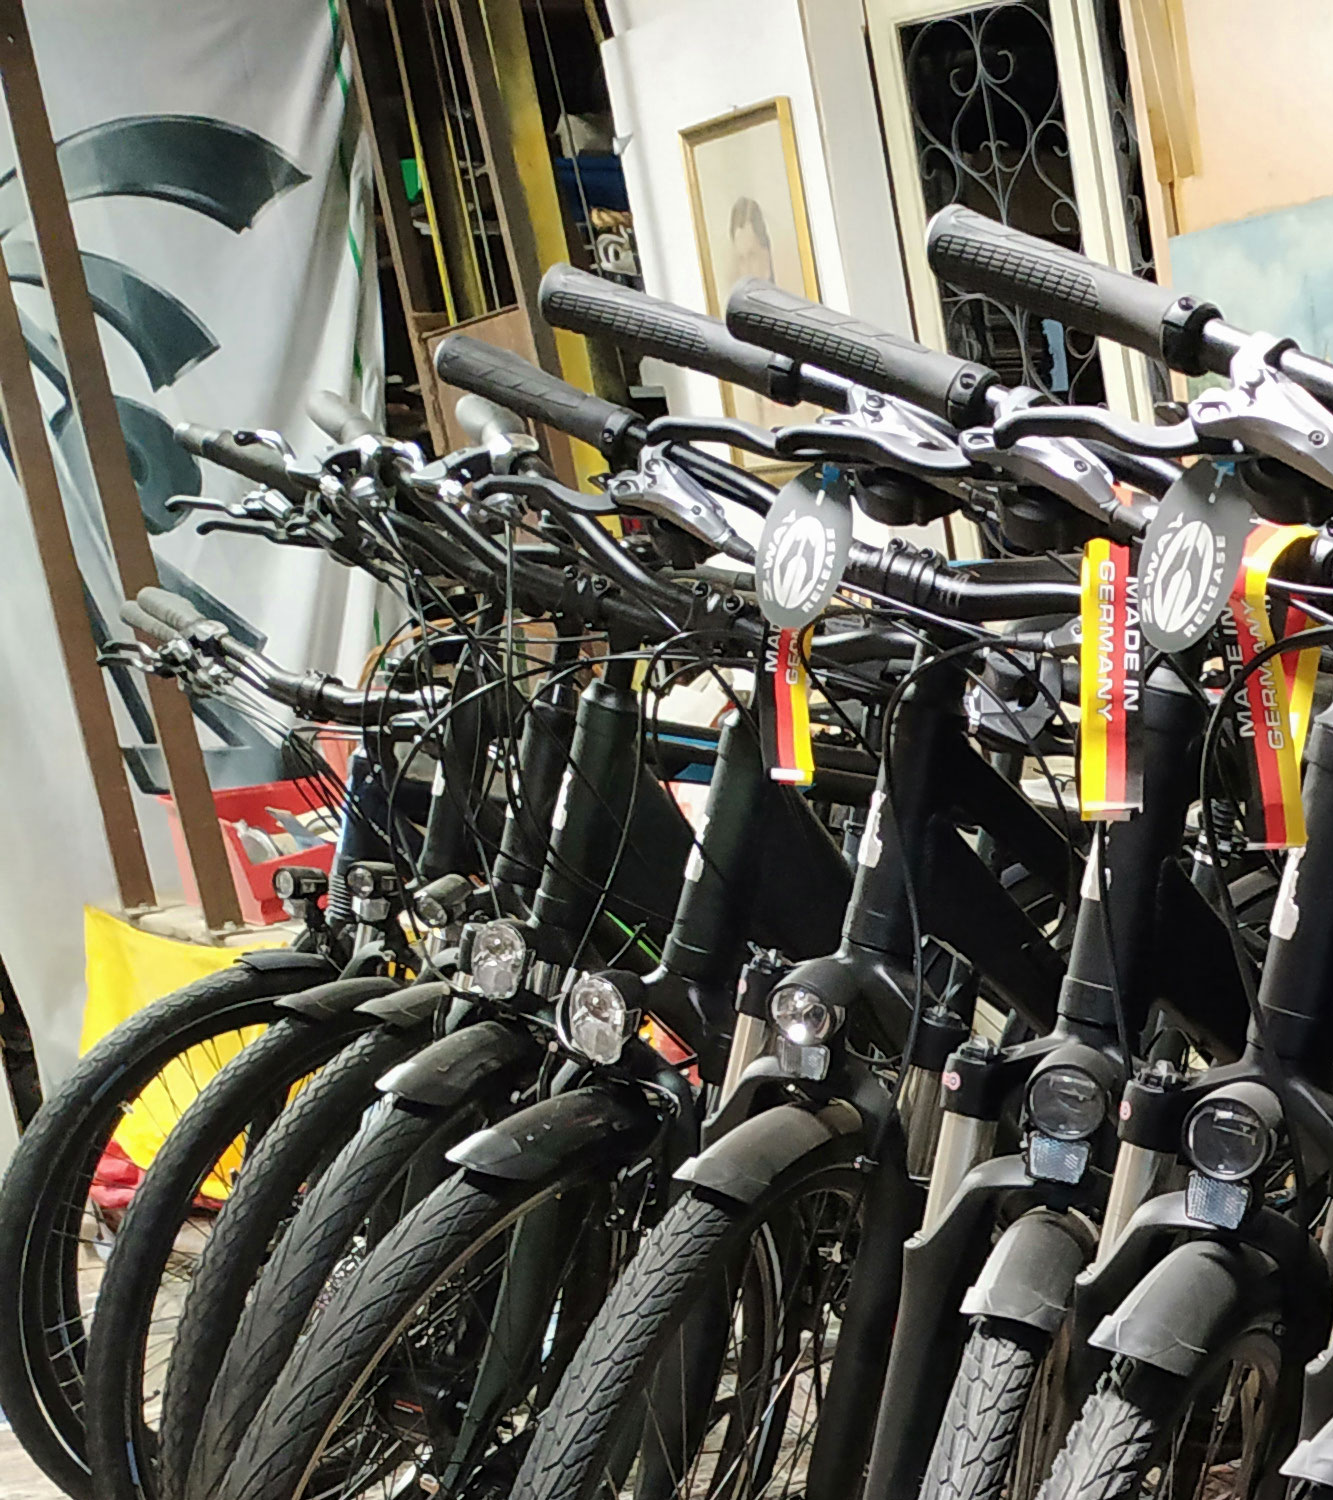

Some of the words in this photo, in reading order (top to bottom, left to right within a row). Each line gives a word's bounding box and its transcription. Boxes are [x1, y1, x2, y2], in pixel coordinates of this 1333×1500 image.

[801, 528, 836, 613] RELEASE
[1183, 535, 1226, 638] RELEASE
[1096, 560, 1116, 722] GERMANY
[1123, 576, 1140, 672] MADE
[1220, 606, 1239, 635] IN
[1122, 679, 1139, 712] IN
